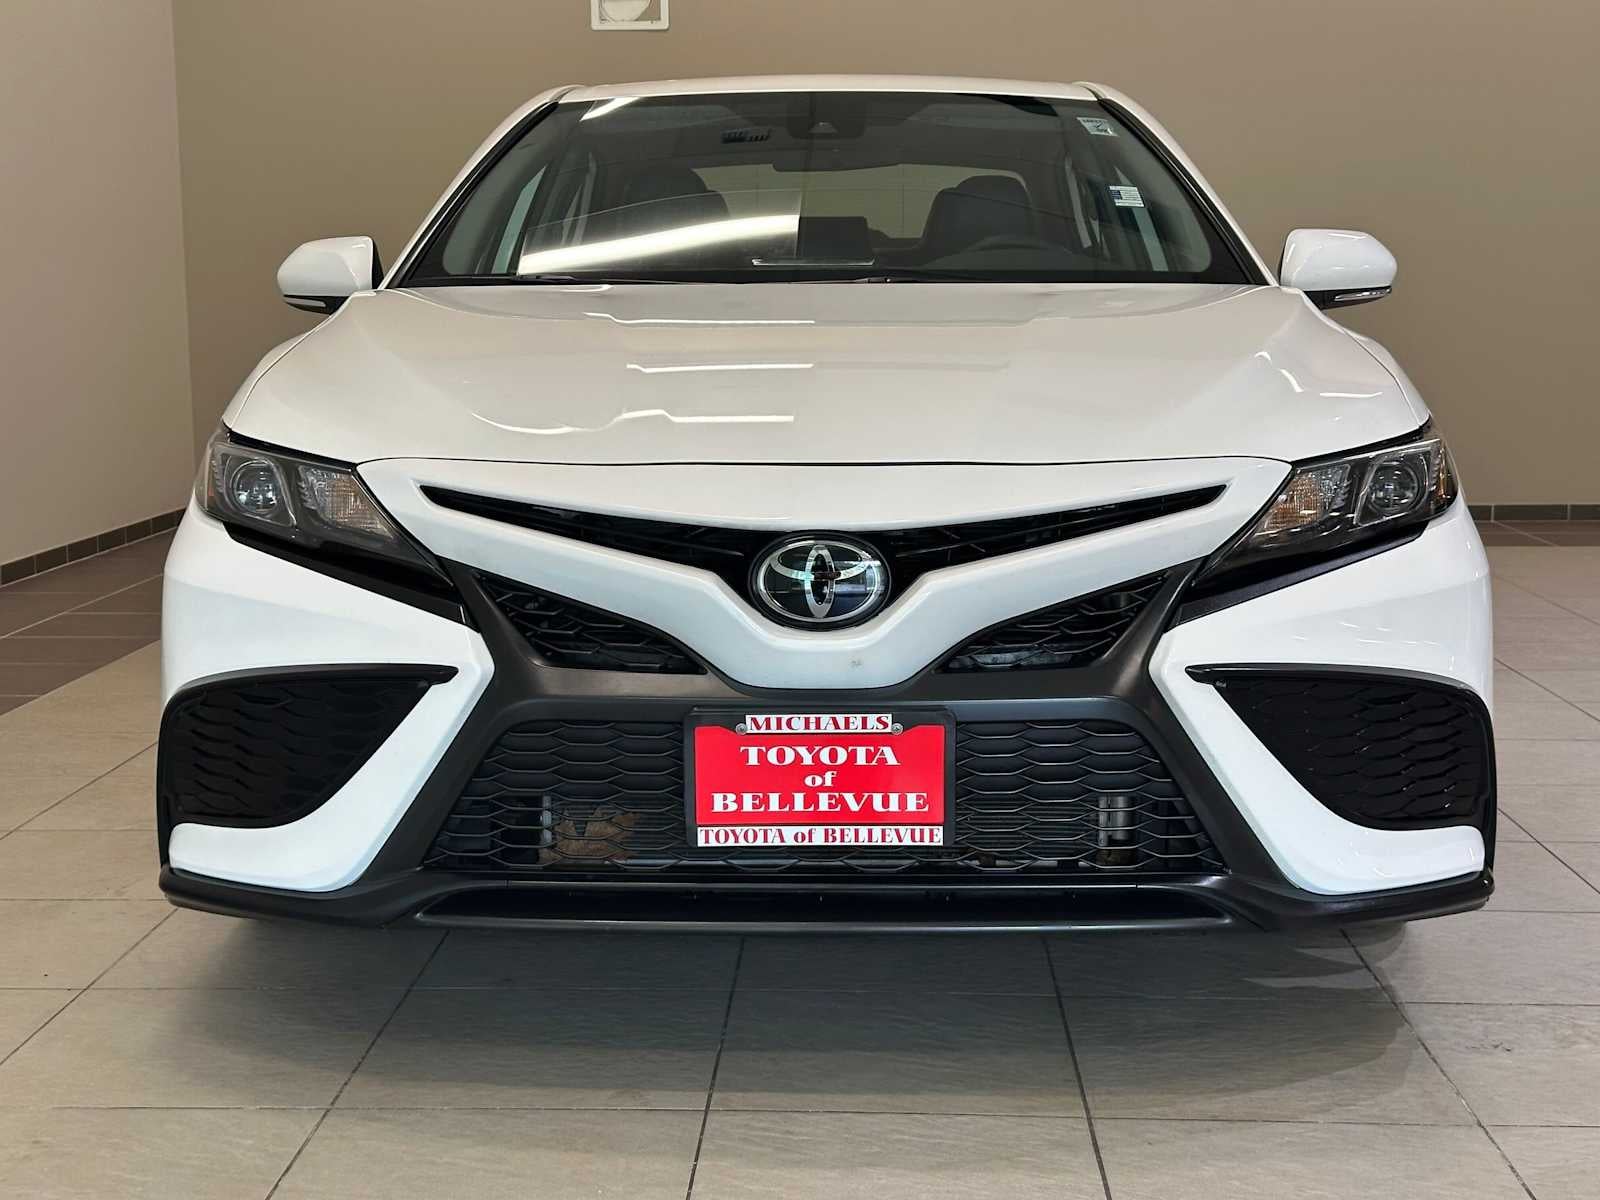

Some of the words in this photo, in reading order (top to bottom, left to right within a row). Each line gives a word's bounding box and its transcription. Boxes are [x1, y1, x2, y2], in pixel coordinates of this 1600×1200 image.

[750, 716, 889, 731] MICHAELS
[740, 746, 899, 766] TOYOTA
[804, 771, 837, 787] of
[711, 792, 928, 812] BELLEVUE
[700, 829, 786, 844] TOYOTA
[793, 828, 816, 843] of
[824, 828, 941, 844] BELLEVUE
